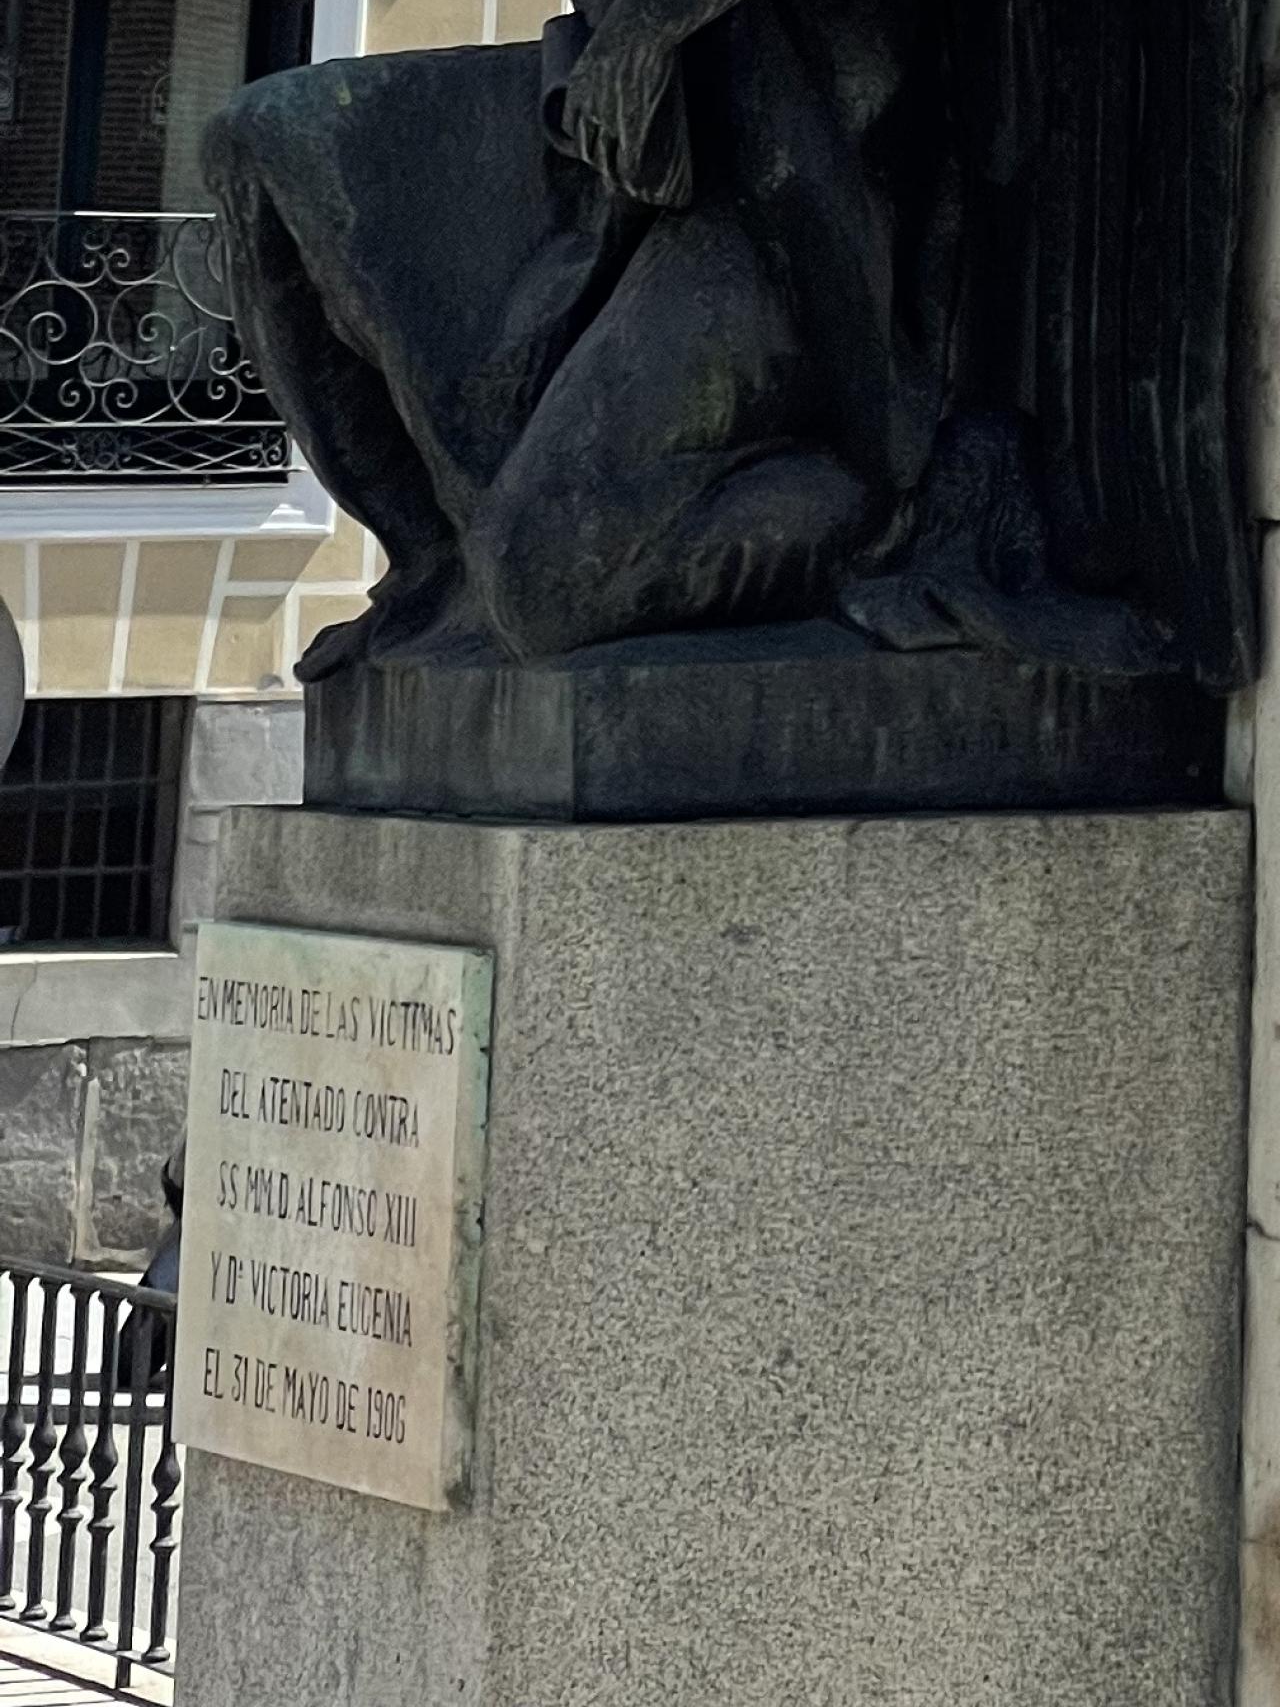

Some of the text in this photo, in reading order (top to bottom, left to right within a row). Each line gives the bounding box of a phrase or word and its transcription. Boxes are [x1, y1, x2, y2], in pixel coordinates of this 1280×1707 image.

[198, 976, 457, 1056] EN MEMORIA DE LAS VICTIMAS
[220, 1068, 420, 1148] DEL ATENTADO CONTRA
[295, 1176, 378, 1238] ALFONSO
[383, 1192, 417, 1248] XIII
[210, 1250, 223, 1302] Y
[250, 1259, 330, 1330] VICTORIA
[337, 1280, 413, 1349] EUGENIA
[203, 1347, 407, 1445] EL 31 DE MAYO DE 1906
